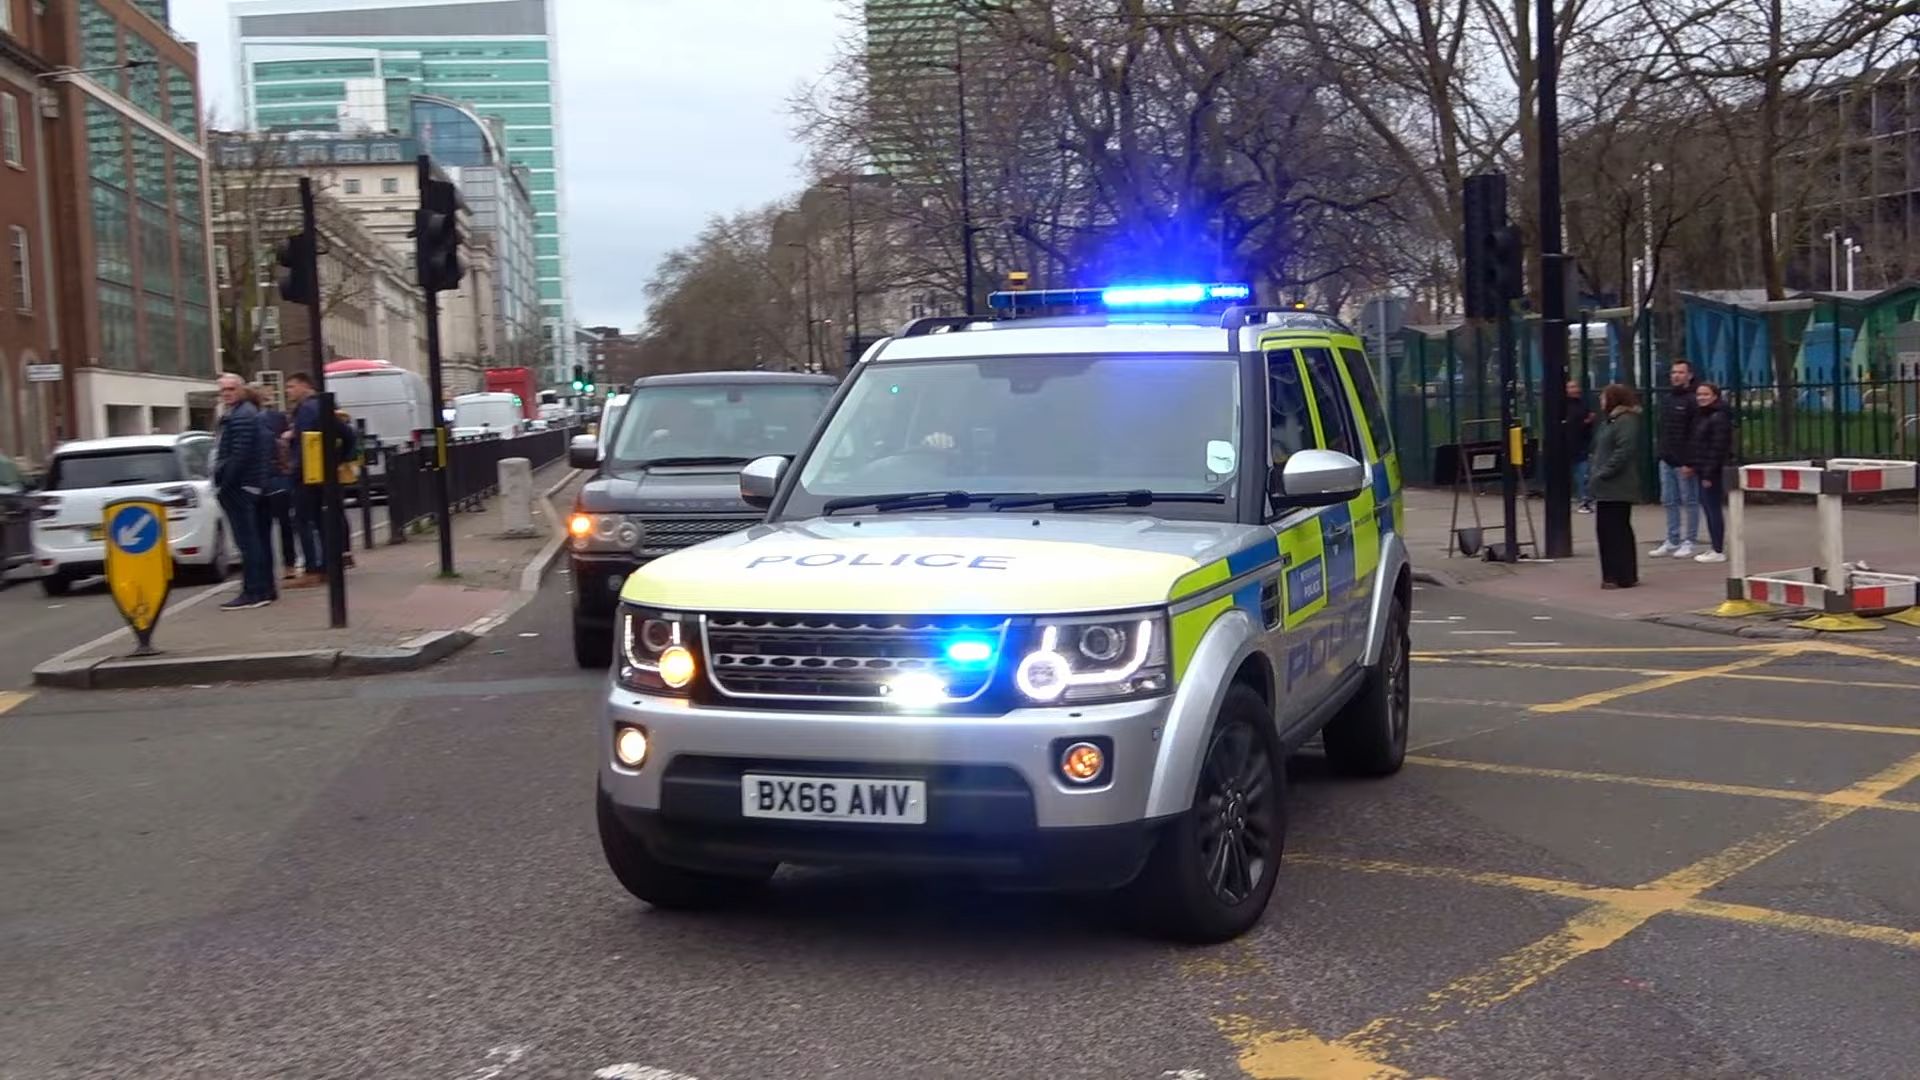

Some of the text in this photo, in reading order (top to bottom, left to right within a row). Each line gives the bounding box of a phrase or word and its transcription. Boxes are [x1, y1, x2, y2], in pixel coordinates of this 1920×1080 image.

[745, 553, 1017, 570] POLICE
[756, 780, 910, 816] BX66 AWV
